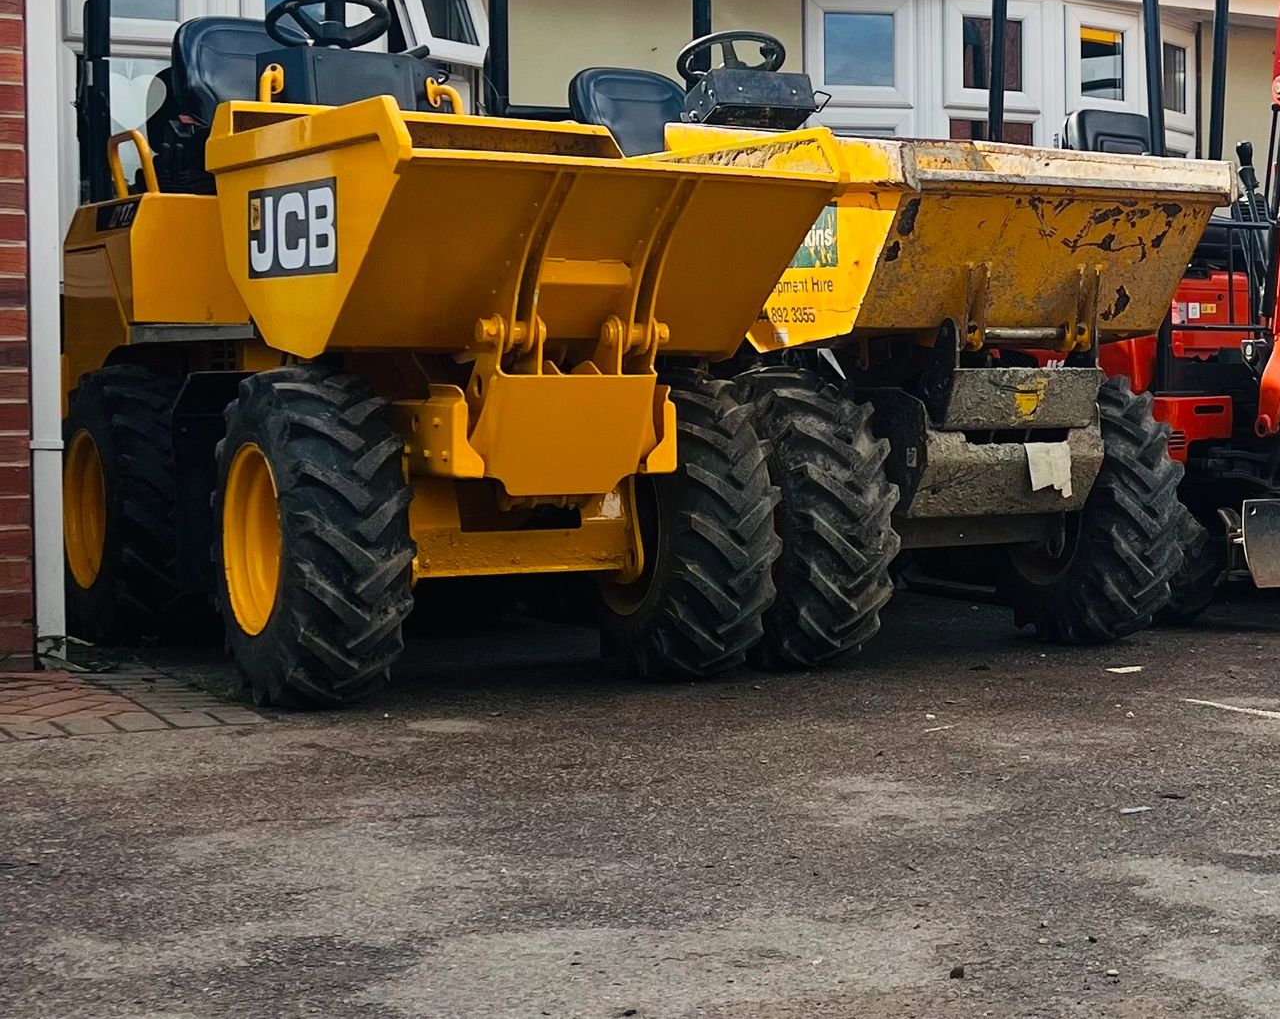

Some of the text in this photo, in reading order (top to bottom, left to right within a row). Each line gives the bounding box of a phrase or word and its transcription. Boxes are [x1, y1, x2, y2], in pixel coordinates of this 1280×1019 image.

[250, 186, 337, 273] JCB
[812, 276, 834, 293] Hire
[771, 307, 789, 323] 892
[791, 307, 816, 323] 3355
